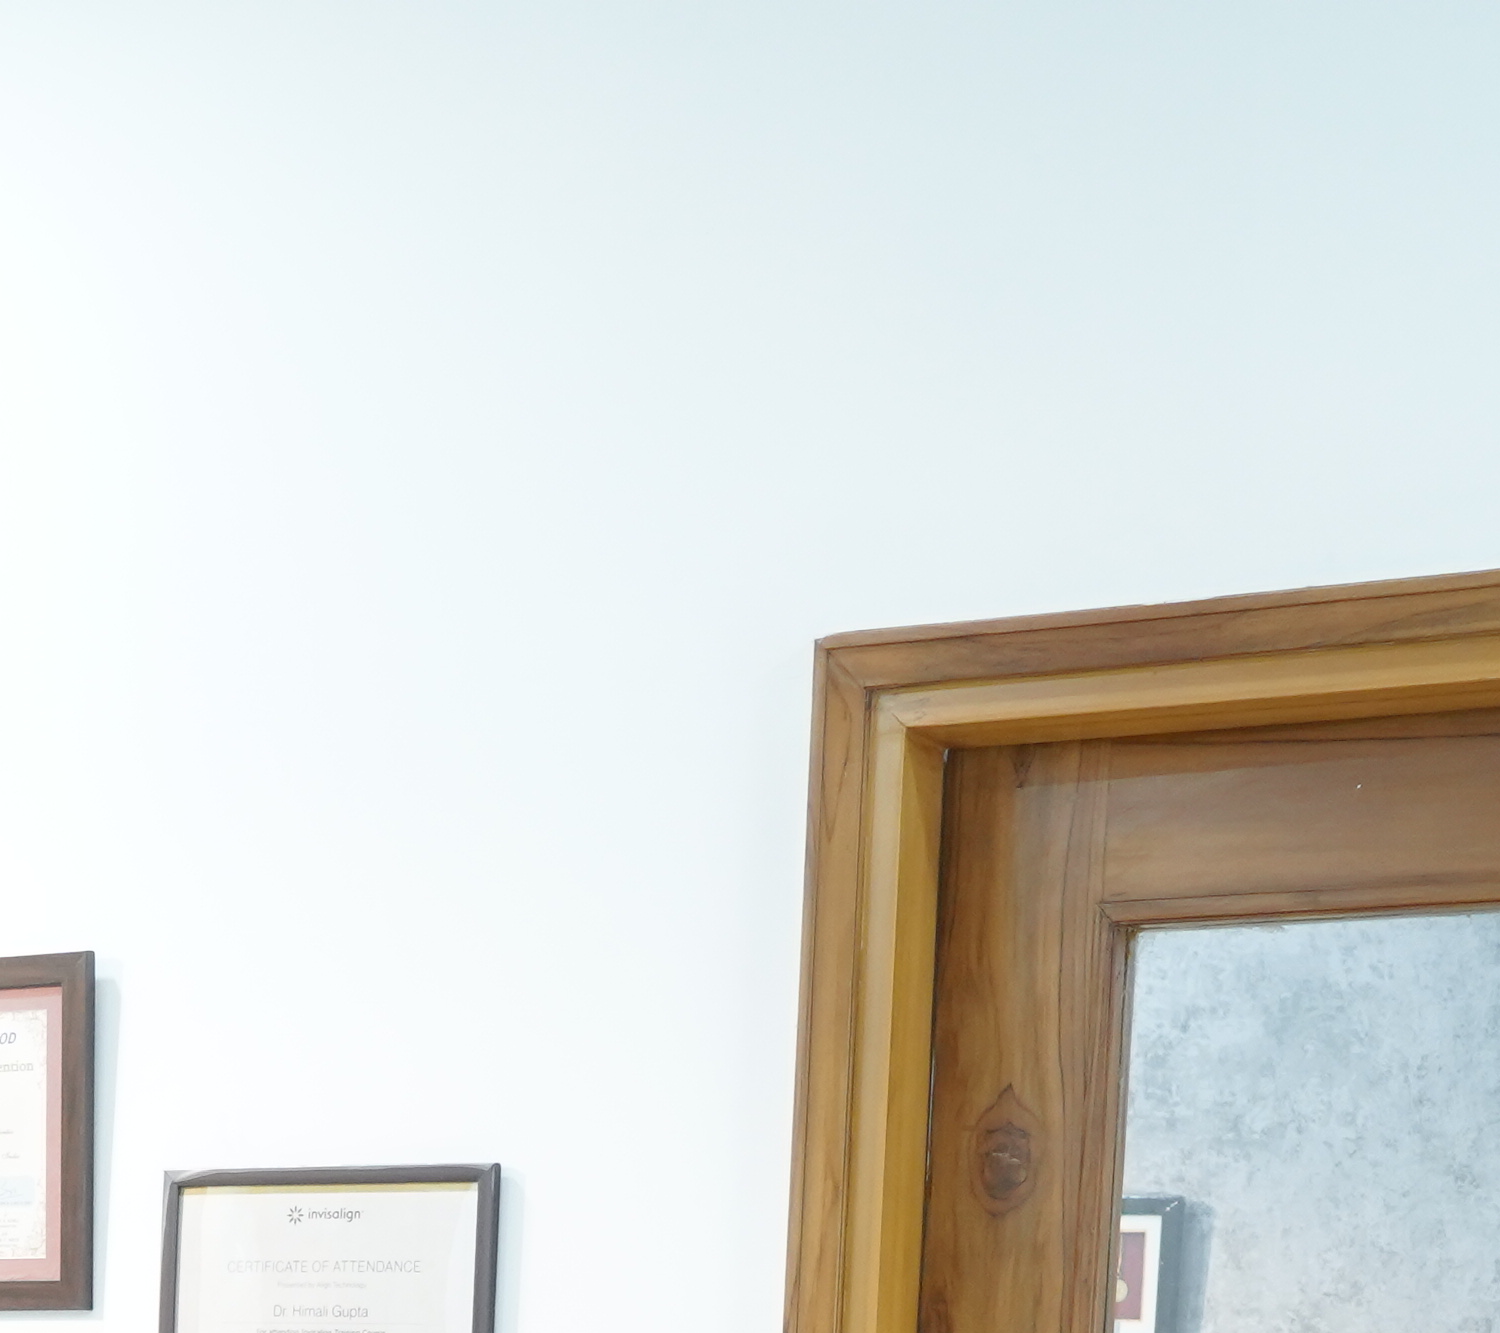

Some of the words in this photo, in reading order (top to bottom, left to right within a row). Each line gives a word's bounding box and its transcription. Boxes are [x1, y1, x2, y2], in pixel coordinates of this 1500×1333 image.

[307, 1207, 362, 1221] invisalign
[227, 1260, 308, 1273] CERTIFICATE
[312, 1260, 330, 1272] OF
[333, 1260, 421, 1273] ATTENDANCE
[292, 1305, 328, 1318] Himali
[332, 1305, 369, 1320] Gupta
